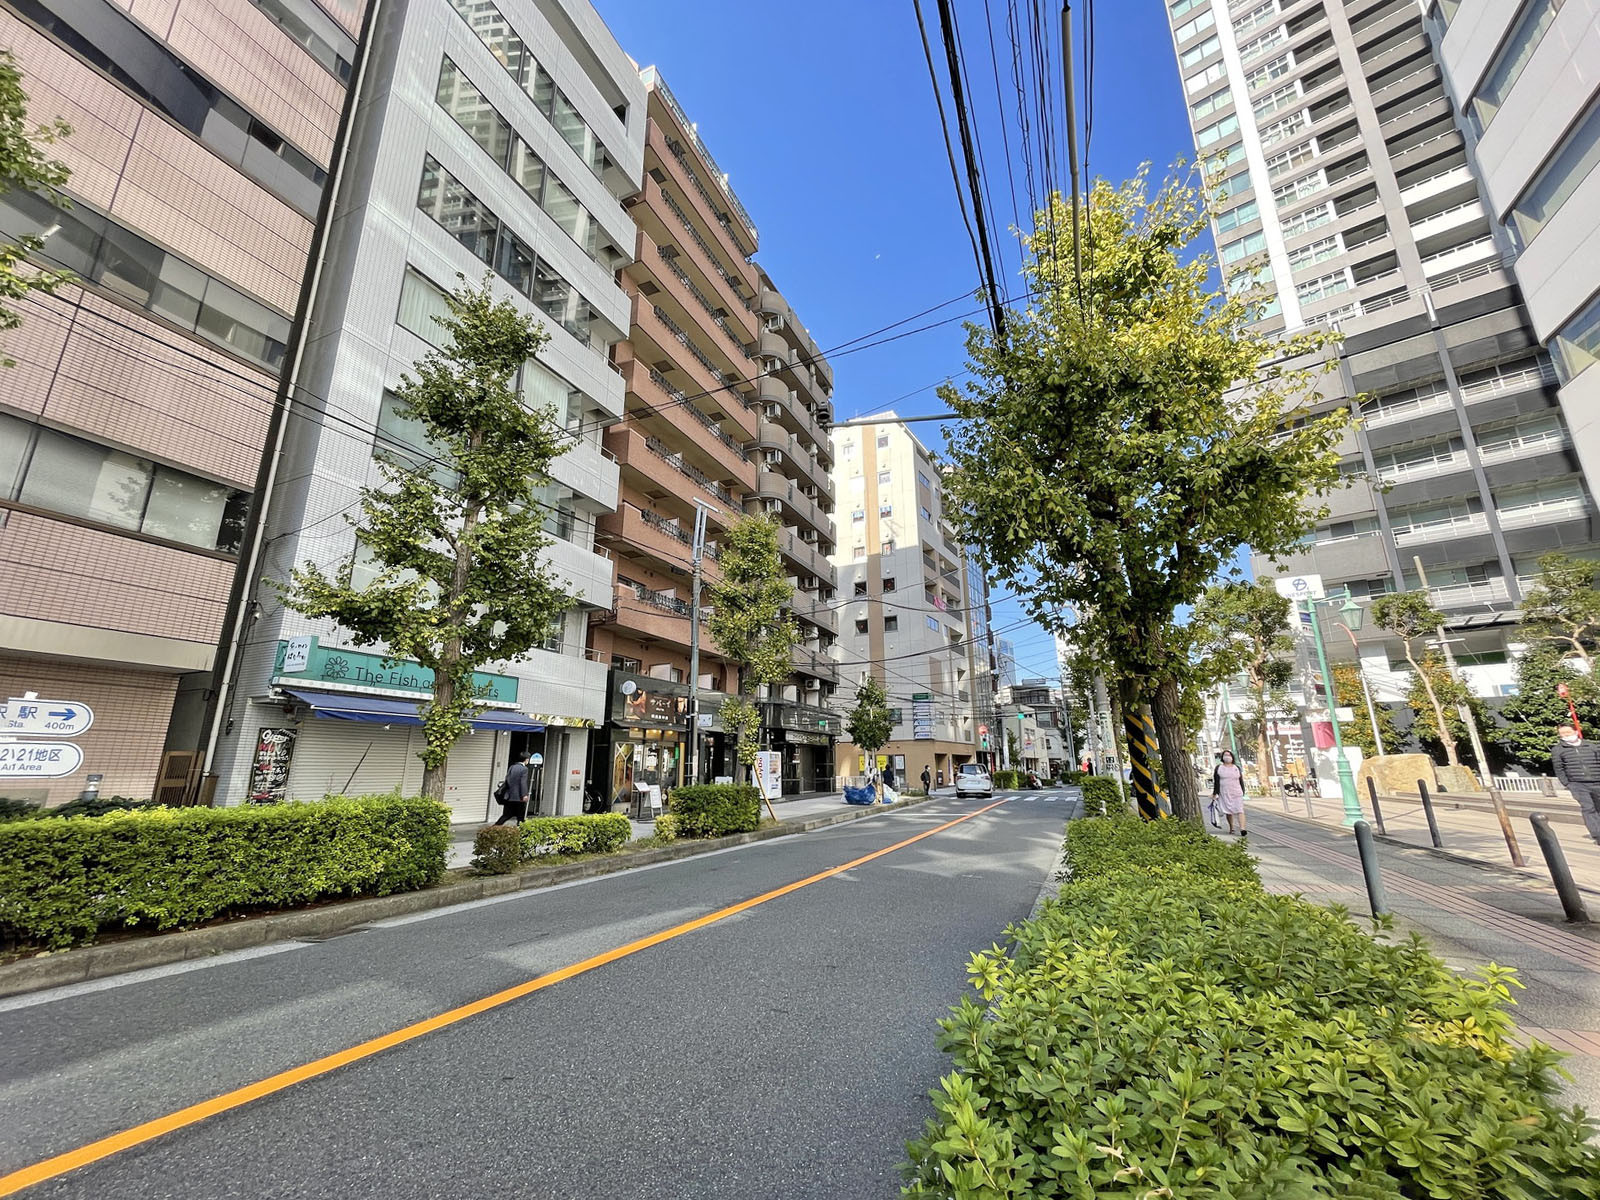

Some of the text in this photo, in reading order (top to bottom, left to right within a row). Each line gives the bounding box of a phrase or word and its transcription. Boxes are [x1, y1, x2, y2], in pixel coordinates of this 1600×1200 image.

[355, 666, 384, 683] The
[389, 671, 418, 688] Fish
[45, 721, 74, 730] 400m
[18, 763, 42, 771] Area
